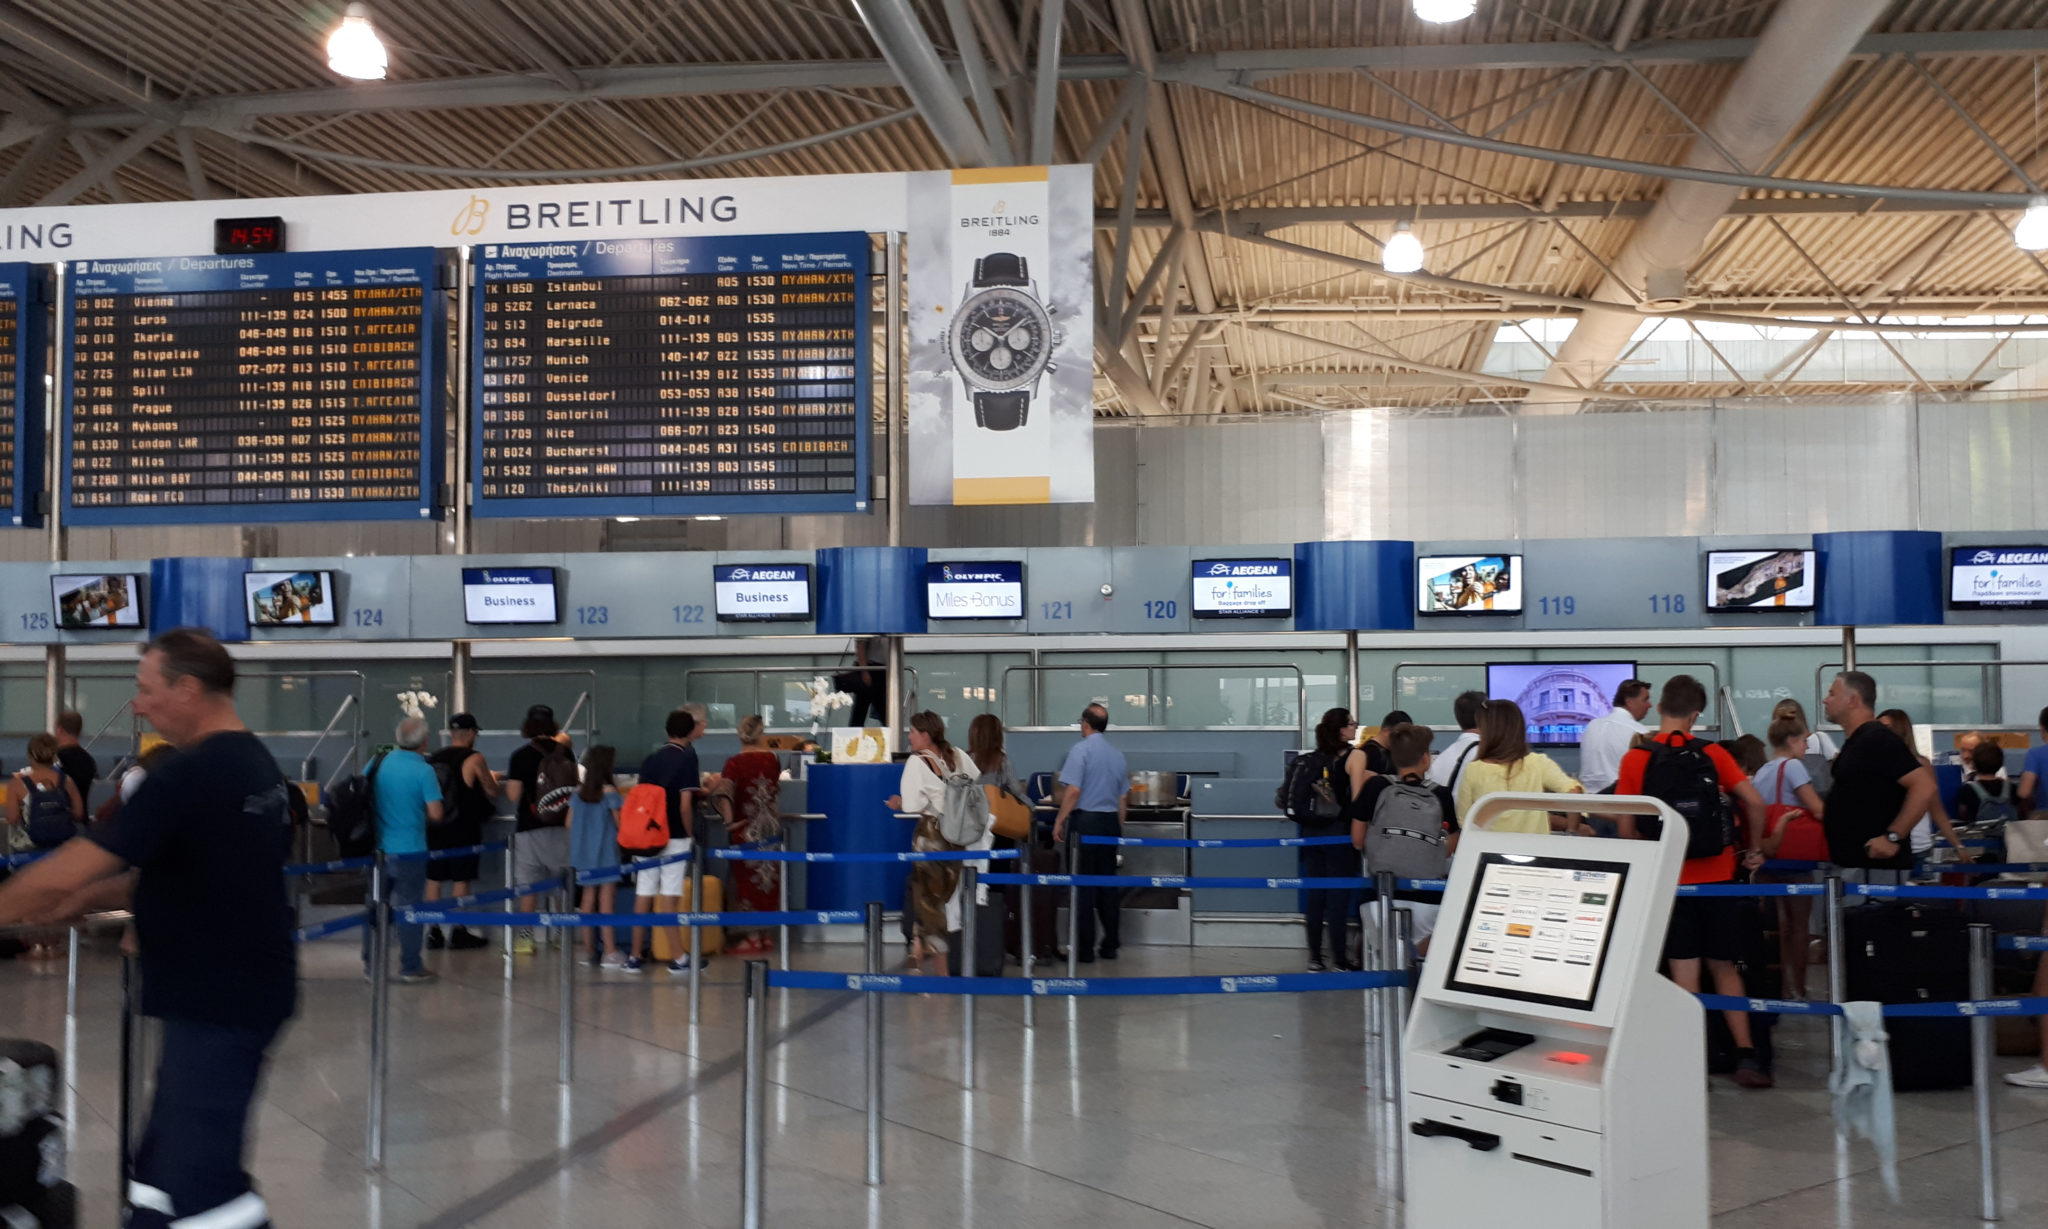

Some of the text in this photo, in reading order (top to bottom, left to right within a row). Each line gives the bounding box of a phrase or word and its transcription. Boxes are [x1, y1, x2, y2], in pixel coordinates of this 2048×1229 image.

[507, 195, 738, 230] BREITLING
[960, 215, 1039, 228] BREITLING
[0, 222, 73, 250] ING
[988, 228, 1010, 237] 1884
[501, 243, 577, 260] Αναχωρήσεις
[596, 239, 674, 256] Departures
[91, 261, 162, 275] Αναχωρήσεις
[179, 257, 255, 271] Departures
[547, 281, 602, 292] Istanbul
[748, 276, 774, 286] 1530
[134, 297, 173, 308] Vienna
[322, 290, 347, 301] 1455
[547, 299, 595, 310] Larnaca
[748, 294, 775, 304] 1530
[133, 315, 166, 325] Leros
[322, 308, 347, 318] 1500
[547, 318, 602, 330] Belgrade
[748, 313, 775, 323] 1535
[133, 332, 173, 343] Ikaria
[321, 326, 347, 336] 1510
[547, 336, 609, 347] Marseille
[748, 331, 775, 341] 1535
[133, 349, 199, 362] Astypalaia
[321, 344, 346, 354] 1510
[547, 355, 588, 365] Munich
[748, 350, 775, 360] 1535
[133, 368, 165, 378] Milan
[172, 367, 192, 377] LIN
[321, 362, 346, 372] 1510
[547, 373, 588, 383] Venice
[748, 368, 775, 378] 1535
[132, 386, 165, 398] Split
[321, 380, 346, 390] 1510
[547, 391, 616, 402] Dusseldorf
[748, 387, 775, 397] 1540
[132, 403, 172, 415] Prague
[320, 398, 346, 408] 1515
[547, 409, 609, 420] Santorini
[749, 405, 775, 415] 1540
[132, 421, 178, 433] Mykonos
[320, 416, 345, 426] 1525
[547, 428, 574, 438] Nice
[749, 424, 775, 434] 1540
[132, 439, 171, 449] London
[178, 438, 198, 448] LHR
[320, 434, 345, 444] 1525
[547, 446, 609, 456] Bucharest
[749, 442, 775, 452] 1545
[131, 456, 164, 467] Milos
[320, 452, 345, 462] 1525
[546, 464, 588, 475] Warsaw
[595, 464, 615, 474] WAW
[749, 461, 775, 471] 1545
[131, 474, 164, 484] Milan
[171, 473, 191, 484] BGY
[319, 470, 345, 480] 1530
[546, 482, 608, 493] Thes/niki
[749, 479, 775, 489] 1555
[131, 492, 157, 502] Rome
[164, 491, 184, 501] FCO
[319, 488, 344, 498] 1530
[1997, 552, 2048, 564] AEGEAN
[752, 571, 795, 580] AEGEAN
[1232, 566, 1278, 575] AEGEAN
[1974, 574, 2041, 589] for families
[736, 593, 789, 603] Business
[936, 593, 968, 607] Miles
[1211, 585, 1272, 600] for families
[484, 596, 535, 606] Business
[1539, 596, 1575, 615] 119
[1649, 595, 1685, 613] 118
[577, 606, 608, 624] 123
[673, 605, 704, 623] 122
[1041, 601, 1072, 619] 121
[1144, 601, 1176, 618] 120
[21, 613, 49, 630] 125
[353, 609, 383, 626] 124
[828, 911, 859, 919] ATHENS
[862, 975, 901, 985] ATHENS
[1046, 979, 1087, 989] ATHENS
[1236, 976, 1277, 986] ATHENS
